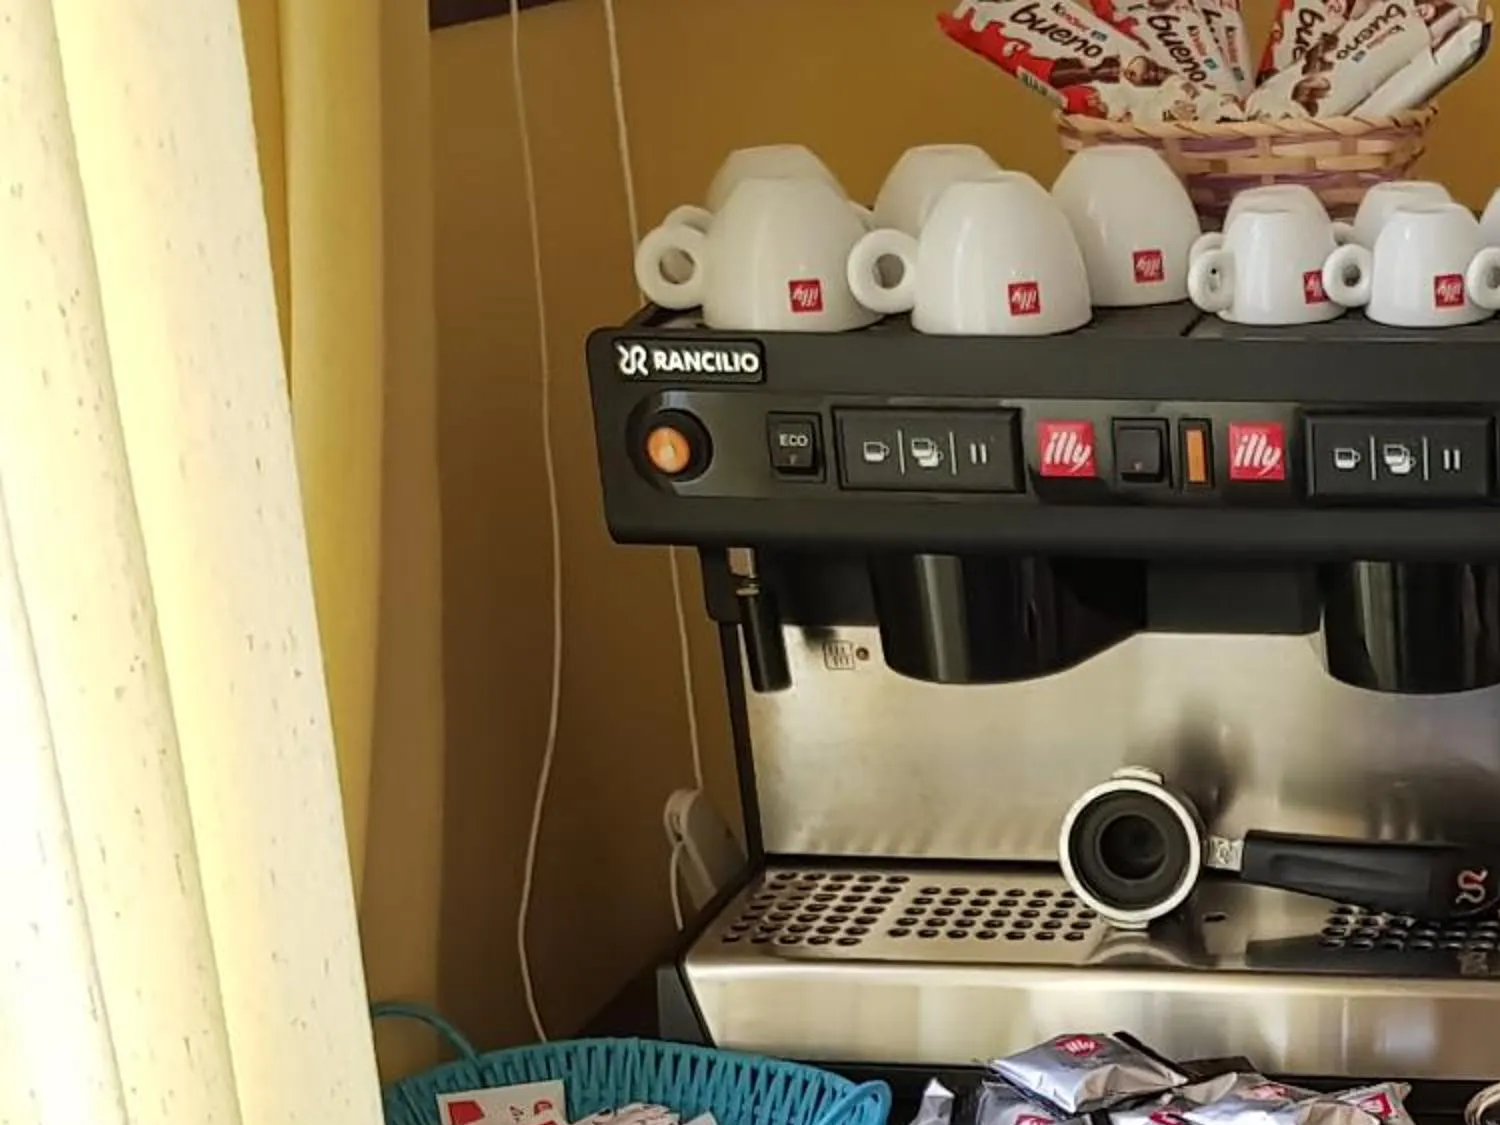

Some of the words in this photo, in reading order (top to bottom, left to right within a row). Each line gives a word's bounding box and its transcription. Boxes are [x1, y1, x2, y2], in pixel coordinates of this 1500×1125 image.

[1010, 3, 1103, 58] bueno
[1148, 14, 1207, 82] bueno
[653, 350, 760, 374] RANCILIO
[780, 433, 809, 447] ECO
[1045, 431, 1092, 473] illy
[1233, 432, 1282, 475] illy
